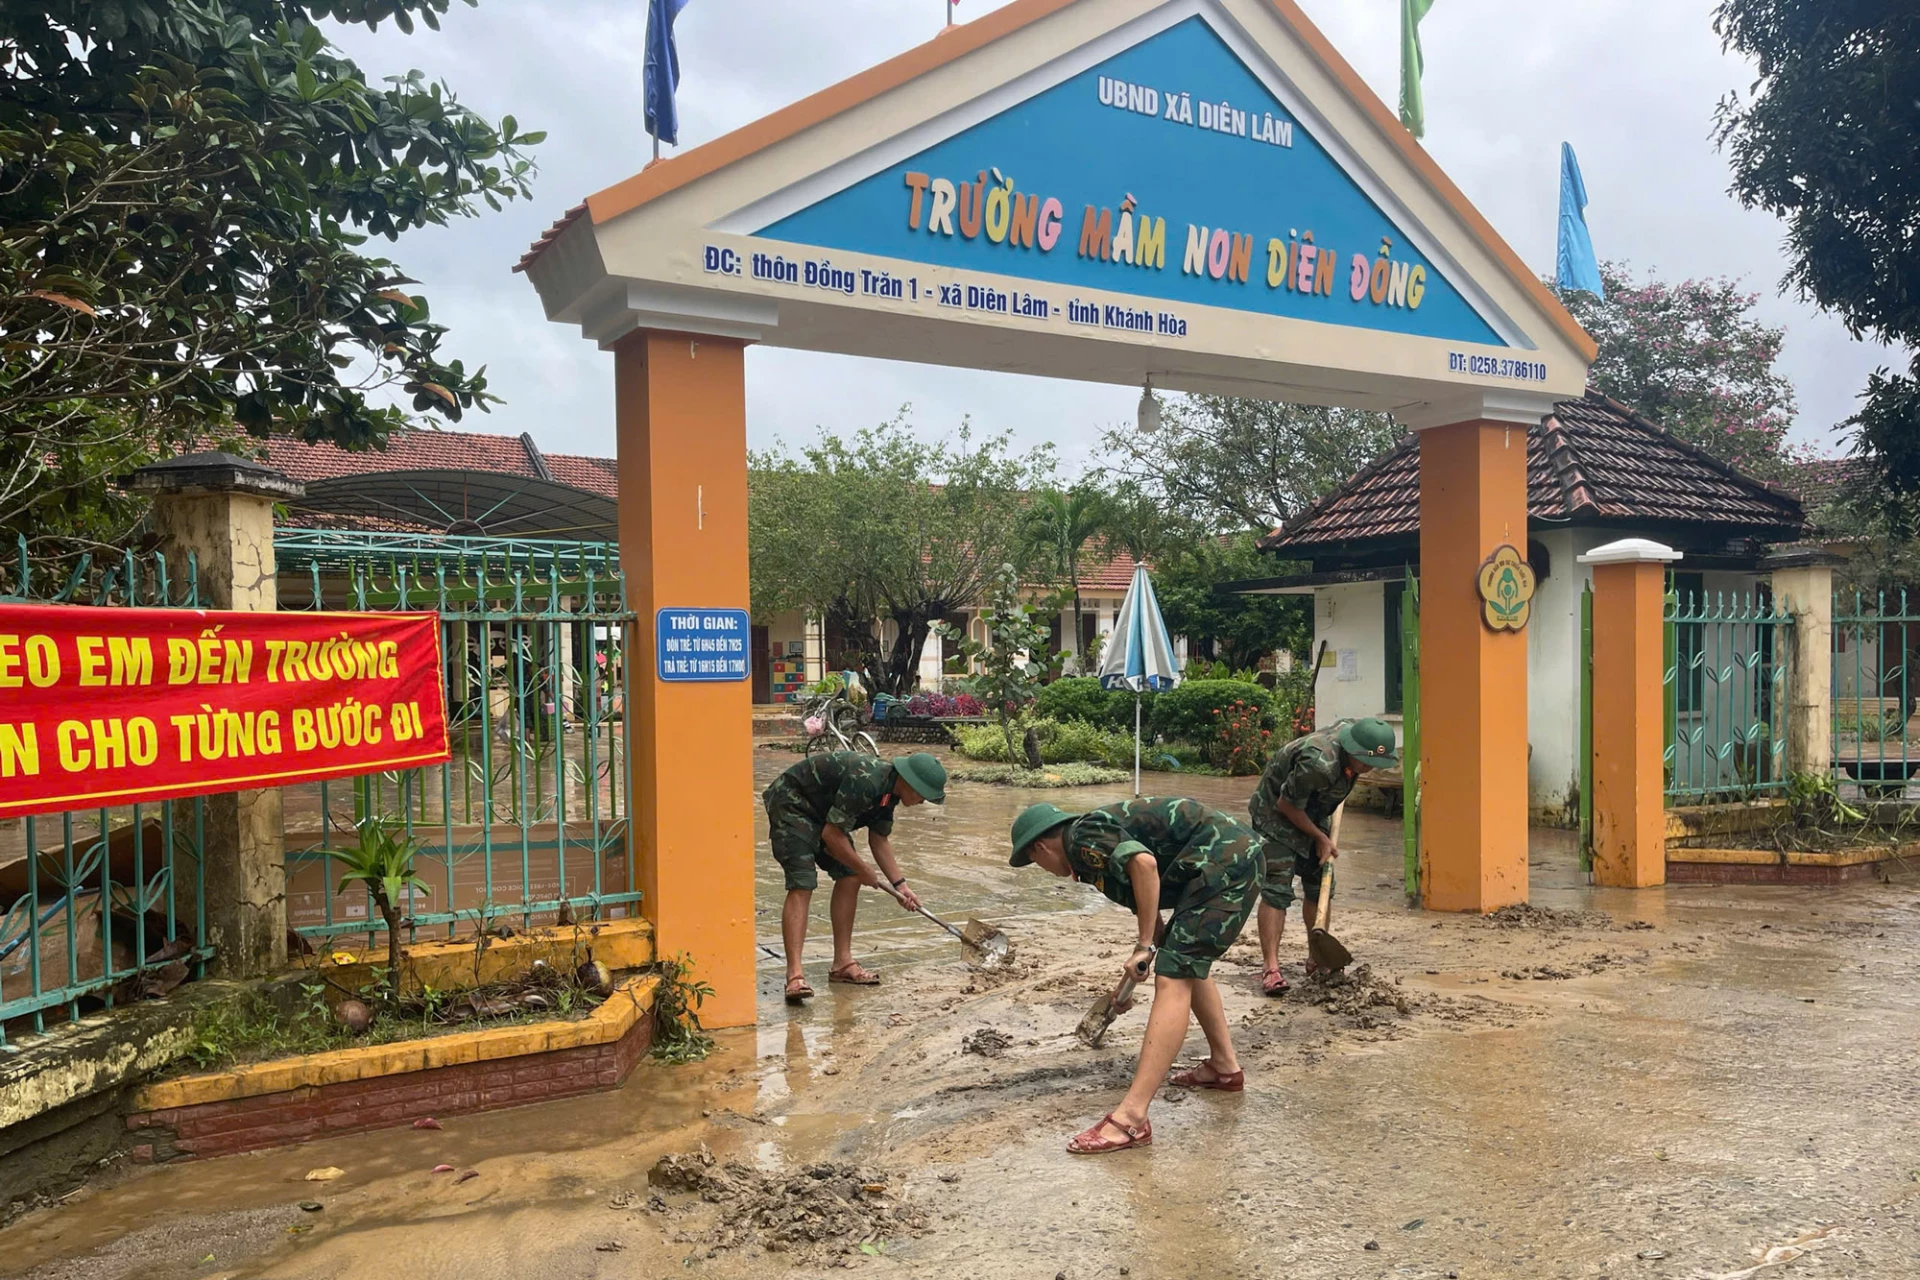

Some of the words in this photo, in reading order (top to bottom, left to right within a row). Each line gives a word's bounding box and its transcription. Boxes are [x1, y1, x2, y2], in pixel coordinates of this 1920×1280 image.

[1098, 76, 1158, 116] UBND
[1164, 92, 1194, 125] XÃ
[1199, 101, 1246, 137] DIÊN
[1251, 112, 1293, 148] LÂM
[905, 167, 1063, 251] TRƯỜNG
[1079, 192, 1165, 269] MẦM
[1183, 223, 1253, 283] NON
[1351, 236, 1426, 309] ĐỒNG
[705, 246, 742, 275] ĐC:
[752, 253, 798, 283] thôn
[804, 260, 855, 293] Đồng
[861, 270, 903, 298] Trăn
[908, 278, 918, 300] 1
[940, 284, 963, 306] xã
[967, 286, 1007, 312] Diên
[1012, 292, 1048, 318] Lâm
[1068, 298, 1099, 325] tỉnh
[1104, 304, 1154, 332] Khánh
[1158, 312, 1187, 337] Hòa
[1470, 355, 1546, 380] 0258.3786110
[666, 636, 679, 652] ĐÓN
[693, 636, 701, 652] TỪ
[716, 634, 728, 652] ĐẾN
[670, 613, 700, 630] THỜI
[703, 616, 738, 630] GIAN:
[76, 636, 154, 686] EM
[167, 624, 253, 685] ĐẾN
[265, 631, 400, 683] TRƯỜNG
[664, 656, 676, 674] TRẢ
[690, 657, 698, 673] TỪ
[716, 655, 728, 673] ĐẾN
[57, 716, 158, 772] CHO
[170, 704, 282, 763] TỪNG
[292, 697, 382, 752] BƯỚC
[390, 702, 424, 742] ĐI
